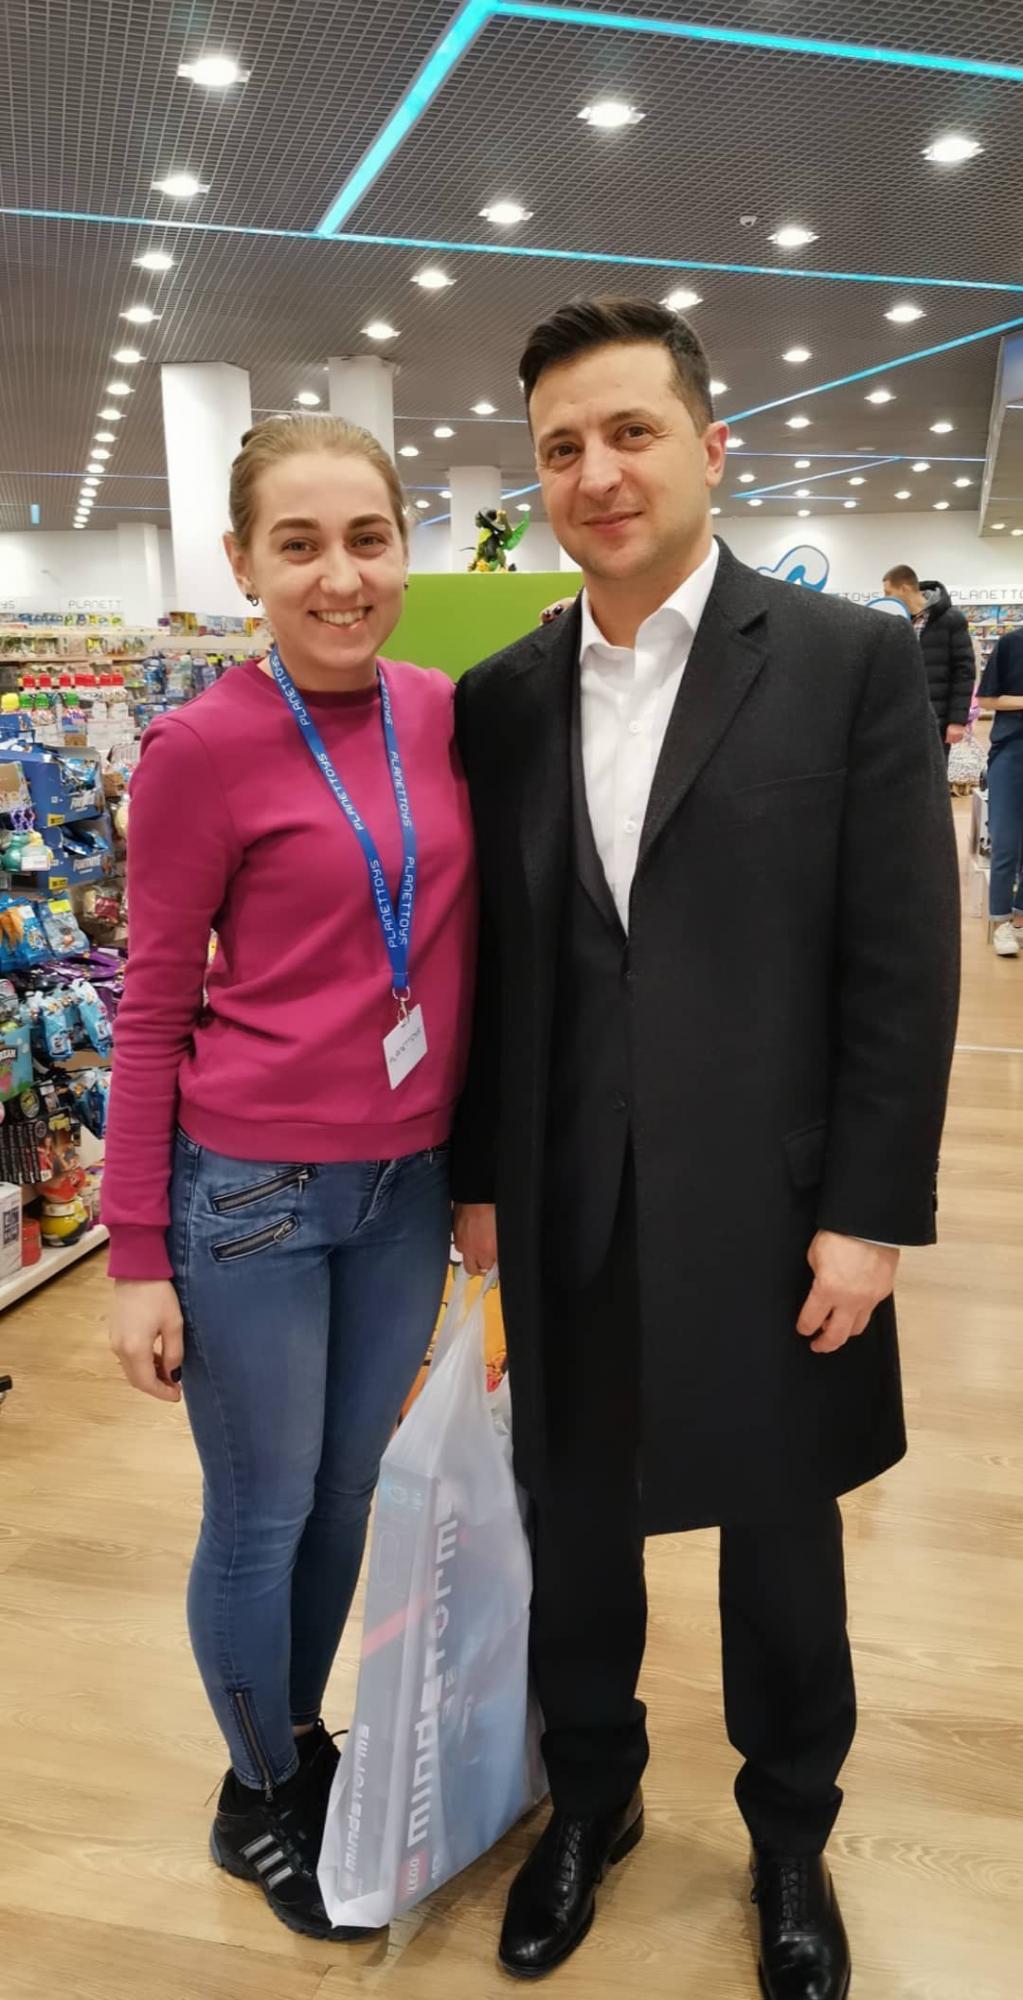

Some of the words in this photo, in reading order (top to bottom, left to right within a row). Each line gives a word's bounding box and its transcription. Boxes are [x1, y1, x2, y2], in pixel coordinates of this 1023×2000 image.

[272, 655, 312, 726] PLANETTOYS
[317, 752, 365, 831] PLANETTOYS
[389, 751, 413, 828] PLANETTOYS
[369, 859, 399, 949] PLANETTOYS
[398, 856, 416, 945] PLANETTOYS
